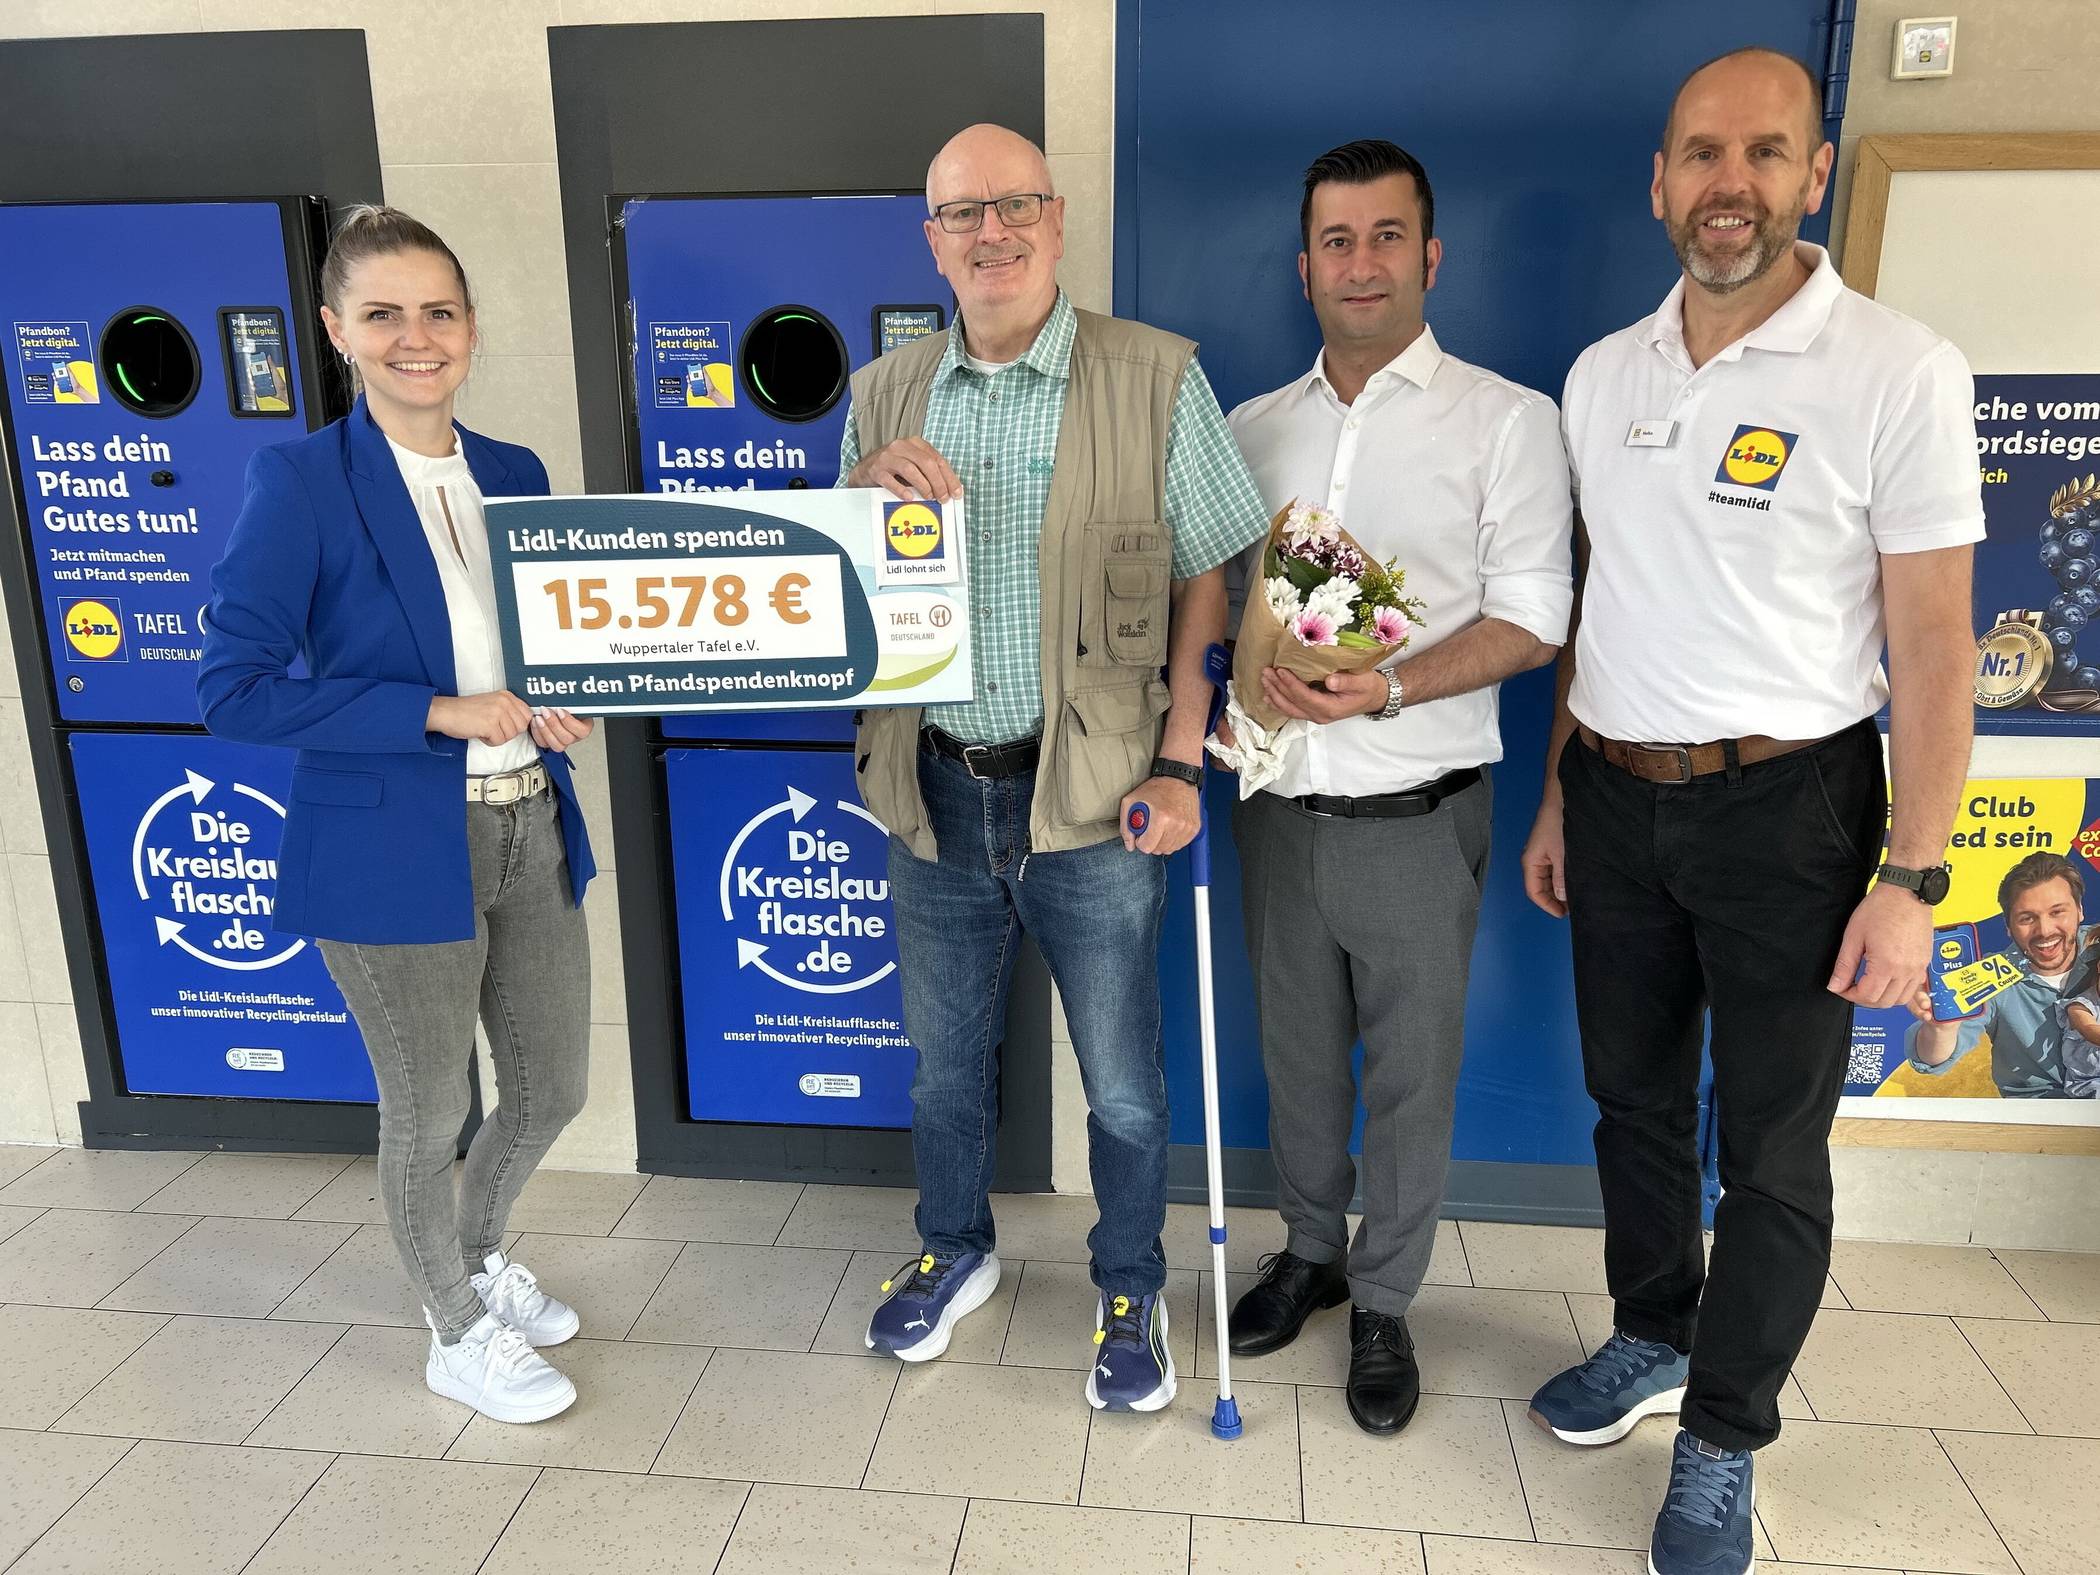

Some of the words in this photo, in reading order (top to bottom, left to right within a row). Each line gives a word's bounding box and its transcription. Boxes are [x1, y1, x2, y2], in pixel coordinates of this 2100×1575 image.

[884, 317, 928, 325] Pfandbon?
[19, 327, 70, 336] Pfandbon?
[253, 328, 279, 336] digital.
[654, 327, 710, 337] Pfandbon?
[885, 326, 904, 334] Jetzt
[905, 326, 934, 335] digital.
[20, 338, 44, 347] Jetzt
[46, 338, 80, 349] digital.
[655, 338, 680, 349] Jetzt
[682, 338, 719, 351] digital.
[2036, 402, 2100, 420] vom
[32, 435, 96, 462] Lass
[104, 435, 171, 462] dein
[658, 441, 725, 469] Lass
[734, 440, 806, 469] dein
[37, 471, 129, 498] Pfand
[1708, 491, 1771, 511] #teamlidl
[43, 507, 131, 533] Gutes
[137, 508, 199, 534] tun!
[508, 527, 668, 552] Lidl-Kunden
[674, 525, 785, 553] spenden
[51, 549, 85, 562] Jetzt
[88, 549, 165, 563] mitmachen
[54, 568, 82, 581] und
[85, 568, 127, 582] Pfand
[130, 569, 190, 584] spenden
[886, 565, 902, 574] Lidl
[904, 564, 927, 573] lohnt
[929, 564, 946, 573] sich
[543, 574, 749, 630] 15.578
[768, 573, 812, 625] €
[134, 613, 187, 634] TAFEL
[889, 613, 922, 625] TAFEL
[890, 633, 935, 641] DEUTSCHLAND
[609, 642, 694, 657] Wuppertaler
[697, 640, 731, 653] Tafel
[735, 640, 760, 652] e.V.
[526, 676, 576, 695] über
[587, 675, 624, 693] den
[630, 668, 855, 693] Pfandspendenknopf
[1968, 796, 2036, 818] Club
[190, 811, 251, 843] Die
[1948, 826, 1986, 848] ed
[1994, 826, 2052, 848] sein
[788, 829, 850, 863] Die
[737, 866, 893, 901] Kreislau
[171, 881, 275, 915] flasch
[758, 901, 885, 938] flasche
[213, 918, 265, 951] .de
[796, 940, 851, 973] .de
[1943, 961, 1963, 970] Plus
[1998, 974, 2019, 987] Coupon
[178, 991, 197, 1002] Die
[199, 991, 315, 1007] Lidl-Kreislaufflasche:
[151, 1008, 181, 1018] unser
[183, 1008, 245, 1020] innovativer
[247, 1009, 347, 1024] Recyclingkreislauf
[755, 1014, 775, 1026] Die
[777, 1014, 900, 1030] Lidl-Kreislaufflasche:
[724, 1031, 756, 1042] unser
[758, 1032, 823, 1044] innovativer
[826, 1033, 912, 1048] Recyclingkreis
